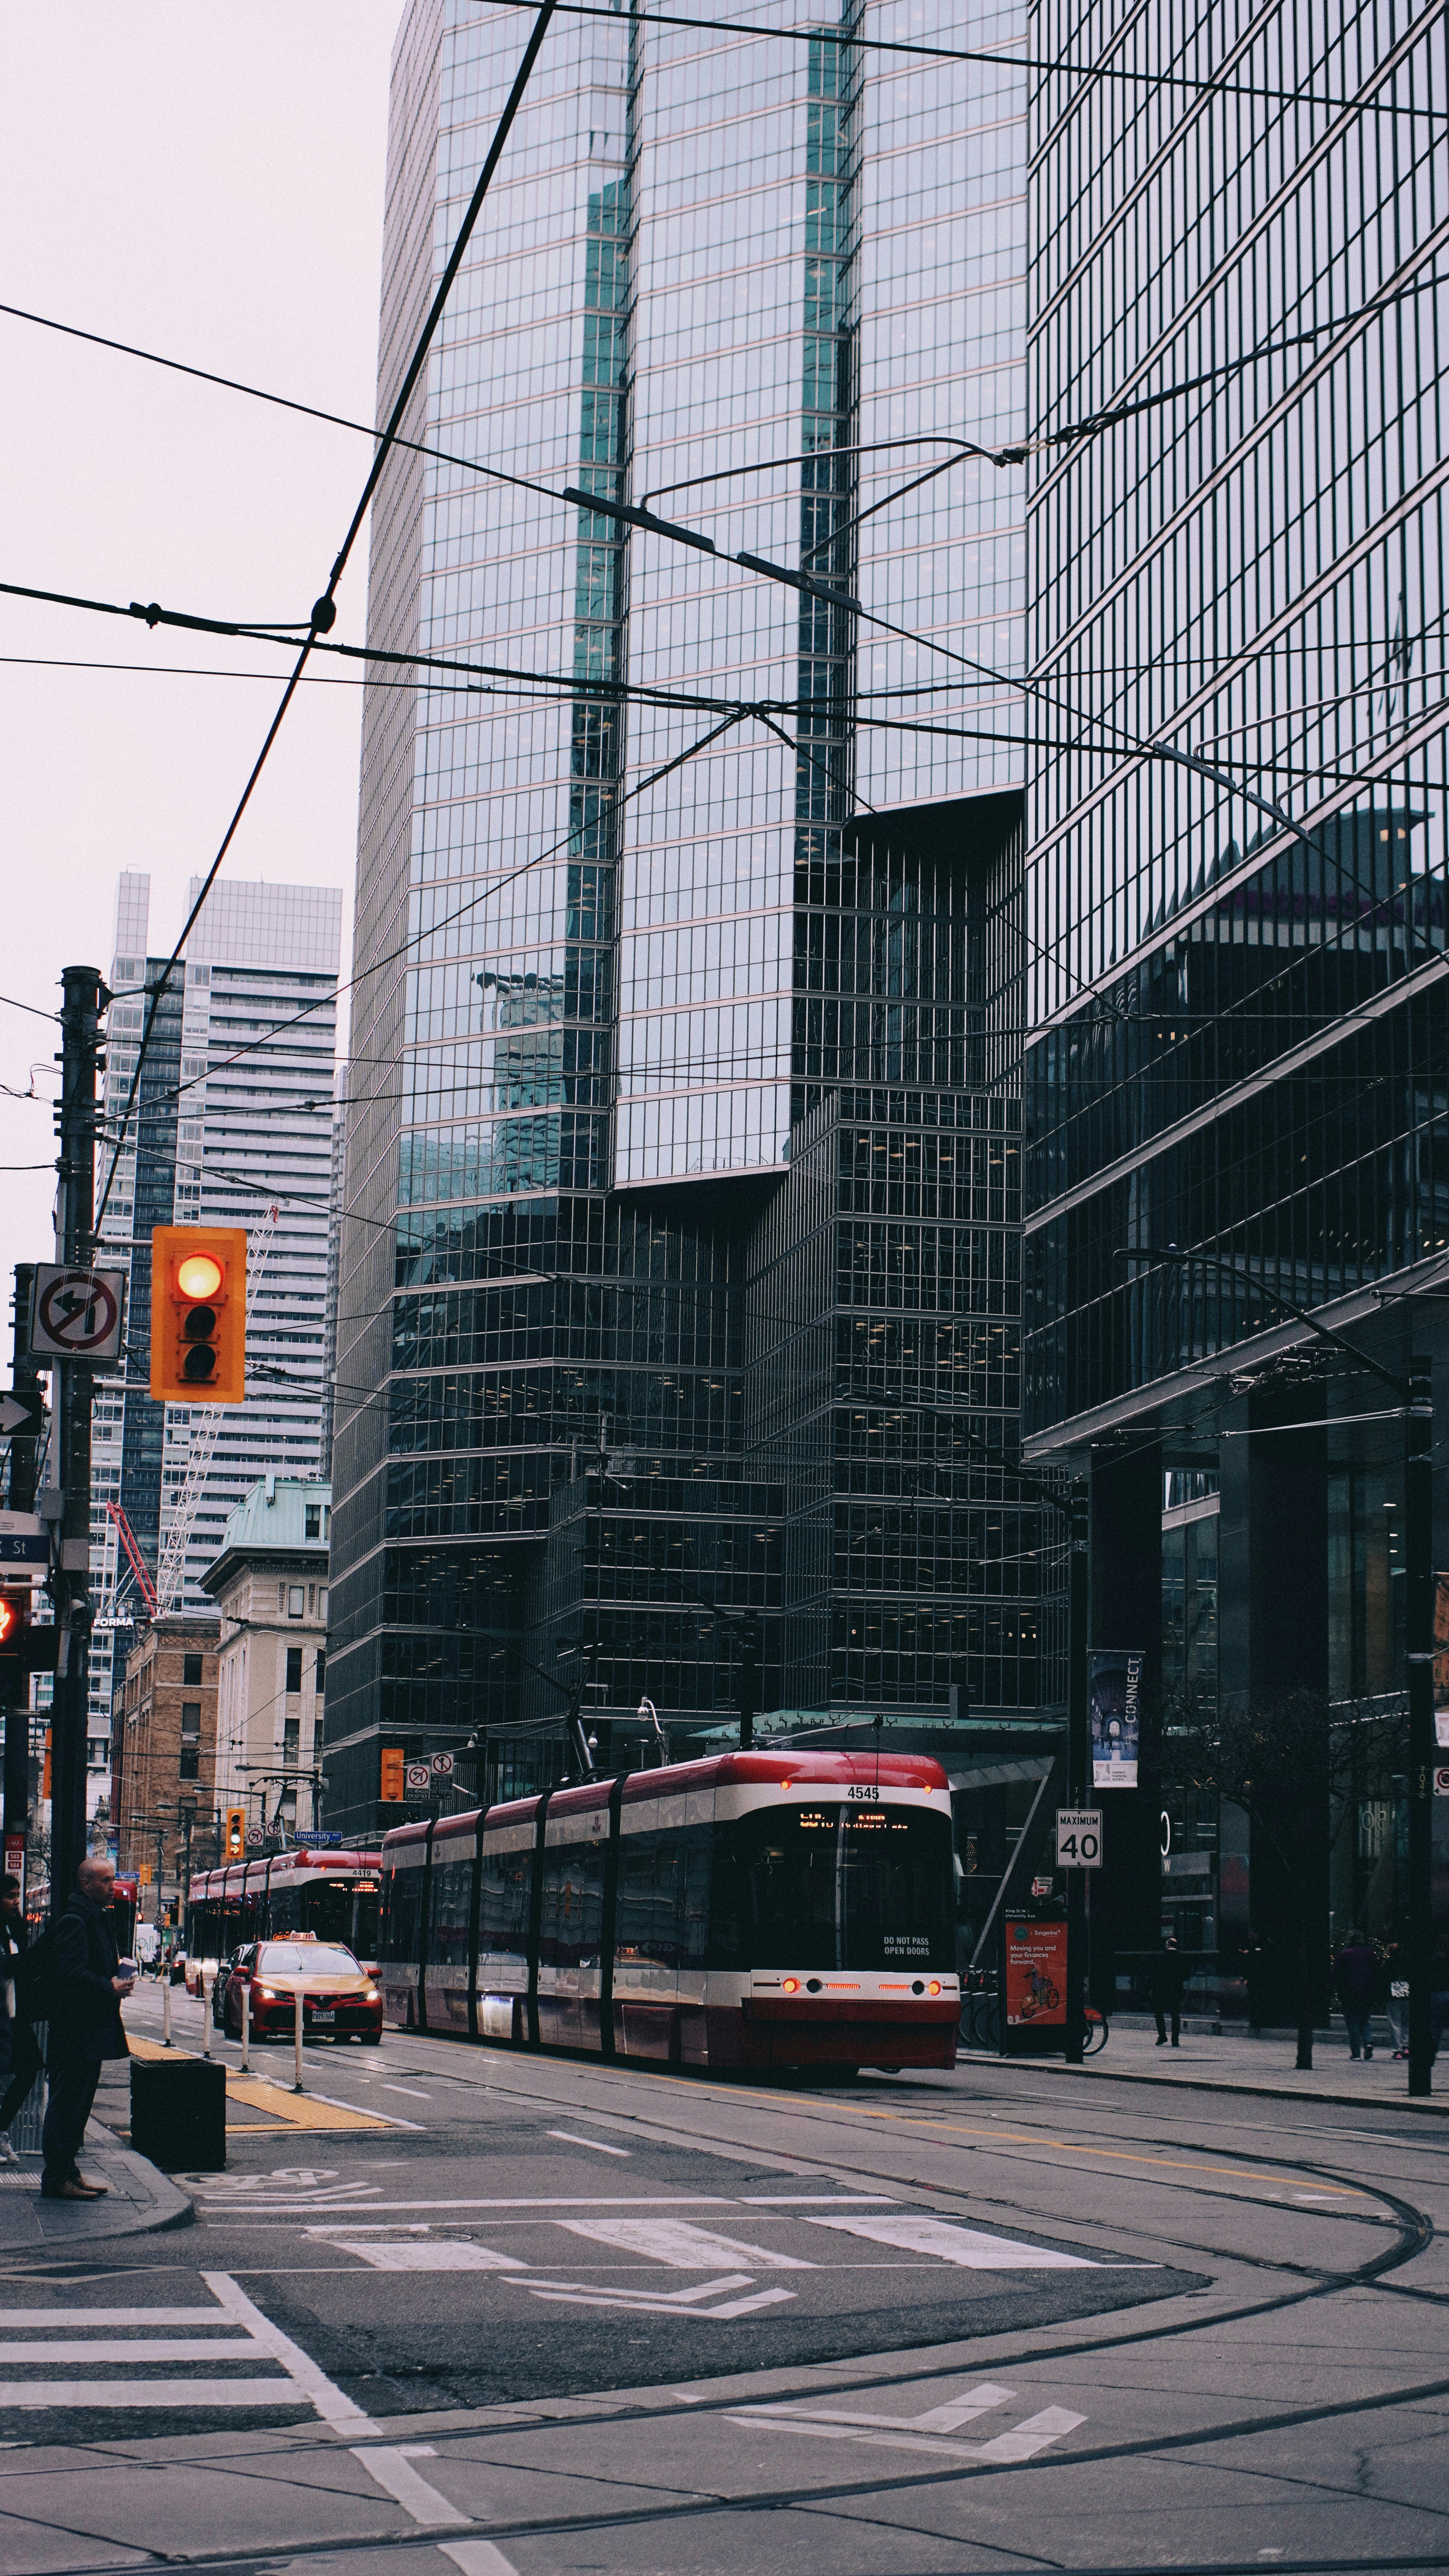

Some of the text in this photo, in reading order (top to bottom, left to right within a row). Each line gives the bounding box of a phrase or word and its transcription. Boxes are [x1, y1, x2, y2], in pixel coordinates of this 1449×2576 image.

[13, 1540, 26, 1554] St
[94, 1617, 134, 1627] FORMA
[1125, 1658, 1140, 1723] CONNECT
[847, 1786, 879, 1799] 4545
[1060, 1817, 1098, 1825] MAXIMUM
[296, 1832, 330, 1841] University
[1060, 1834, 1098, 1859] 40
[1164, 1859, 1171, 1873] W
[912, 1937, 929, 1945] PASS
[885, 1947, 929, 1956] OPEN DOORS
